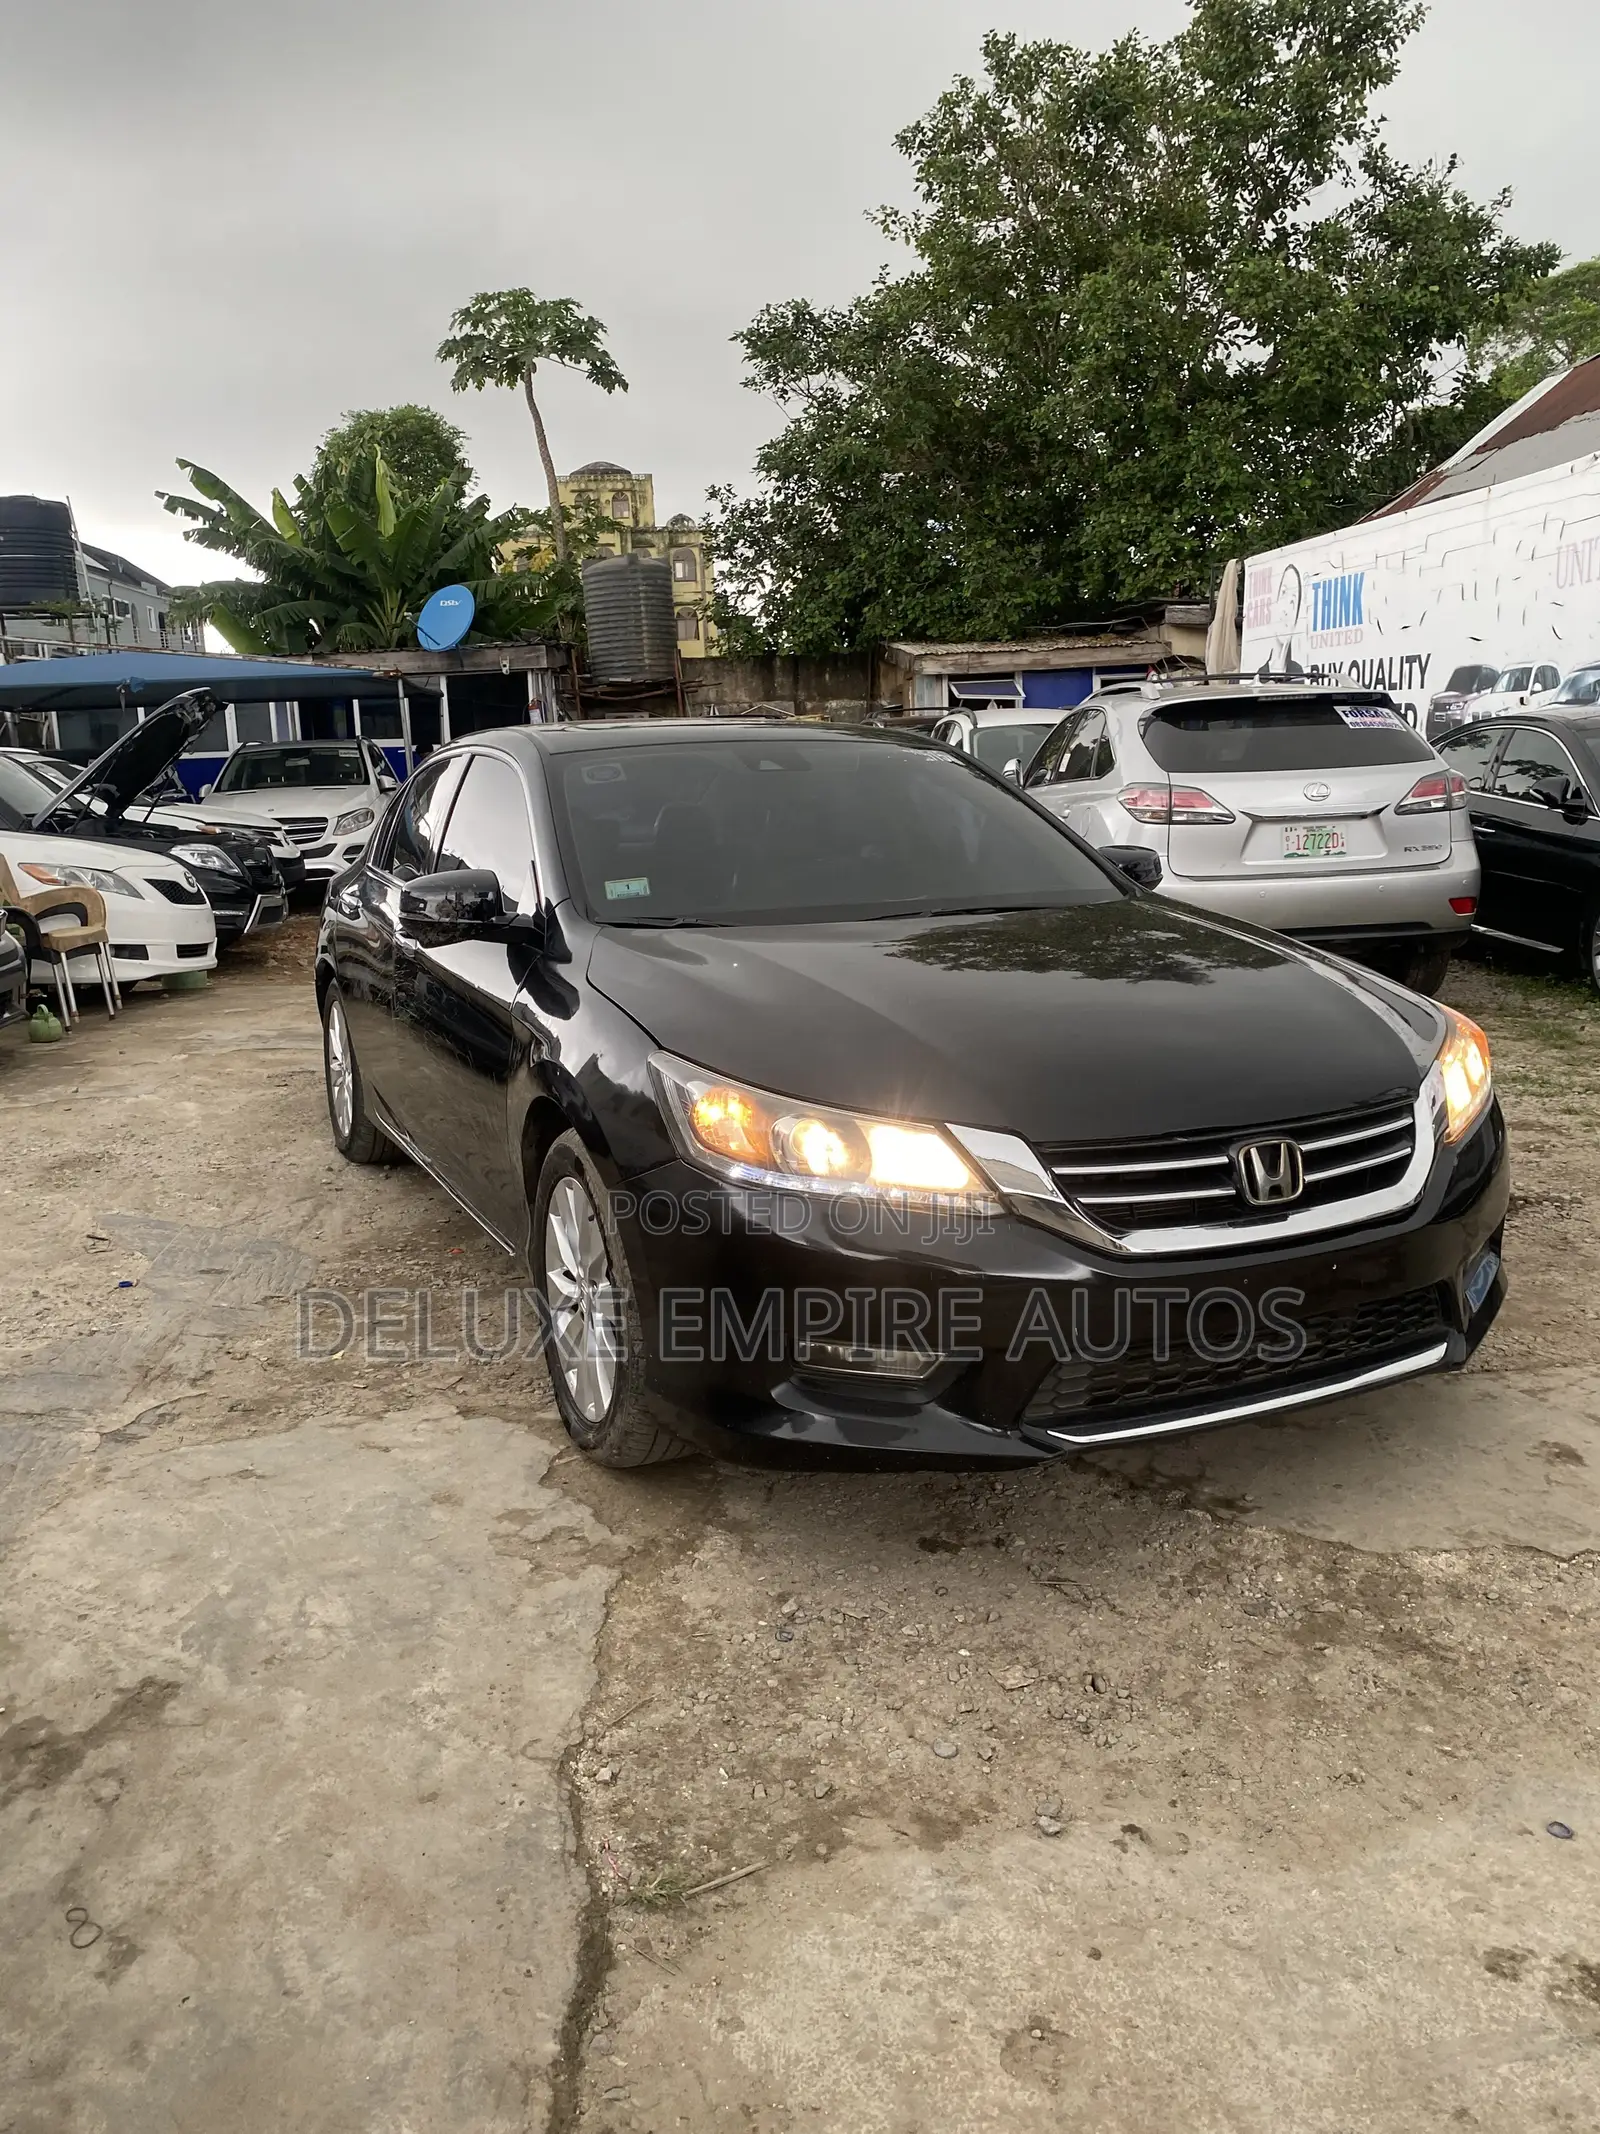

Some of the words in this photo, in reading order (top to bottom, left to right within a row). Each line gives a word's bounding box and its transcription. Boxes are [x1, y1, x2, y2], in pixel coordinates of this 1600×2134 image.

[1311, 572, 1365, 632] THINK
[1310, 628, 1364, 650] UNITED
[1310, 661, 1344, 687] BUY
[1347, 653, 1431, 691] QUALITY
